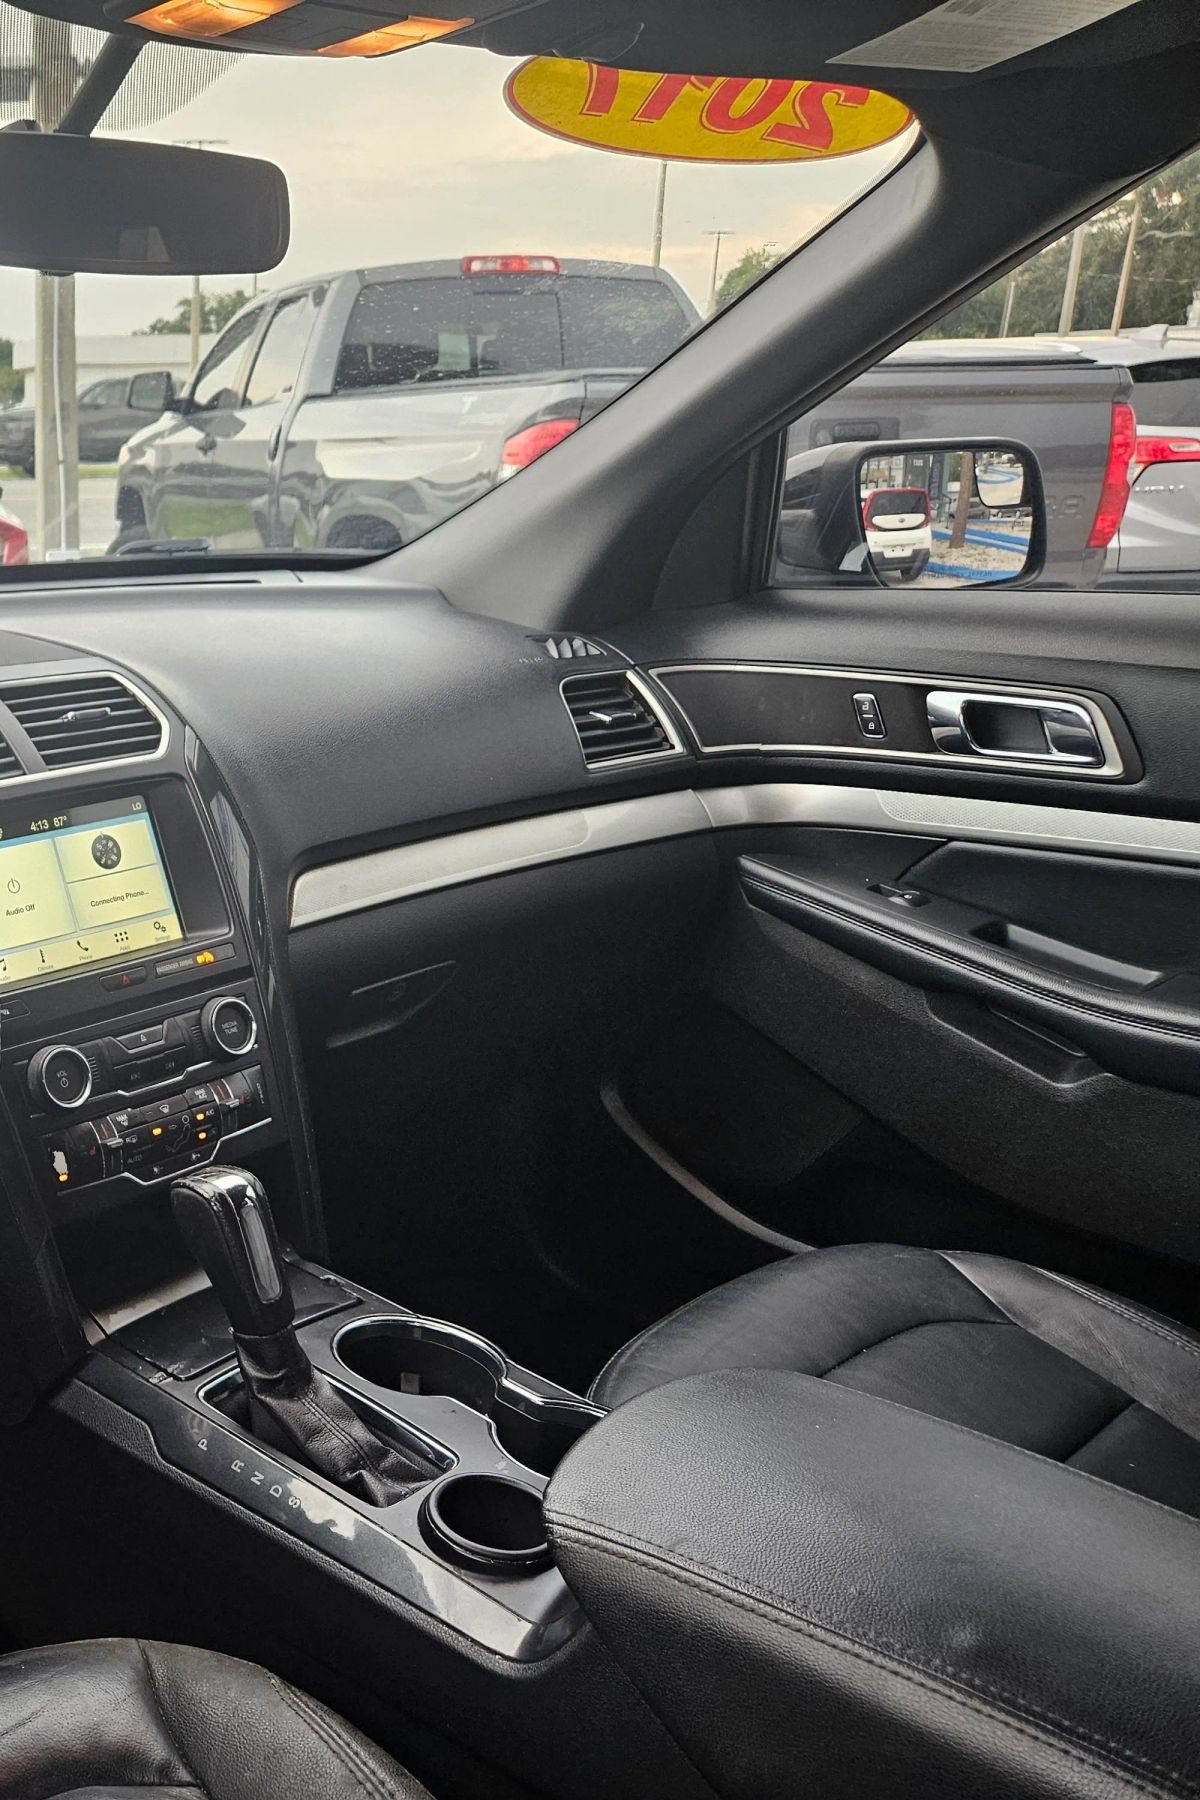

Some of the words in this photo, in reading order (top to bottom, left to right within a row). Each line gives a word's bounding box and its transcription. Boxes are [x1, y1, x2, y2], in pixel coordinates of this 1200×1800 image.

[132, 802, 142, 811] LO
[30, 820, 49, 832] 4:13
[90, 894, 125, 908] Connecting
[6, 906, 24, 917] Audio
[25, 903, 36, 913] Off
[197, 1438, 208, 1451] P
[231, 1459, 245, 1473] R
[250, 1471, 264, 1486] N
[269, 1484, 282, 1498] D
